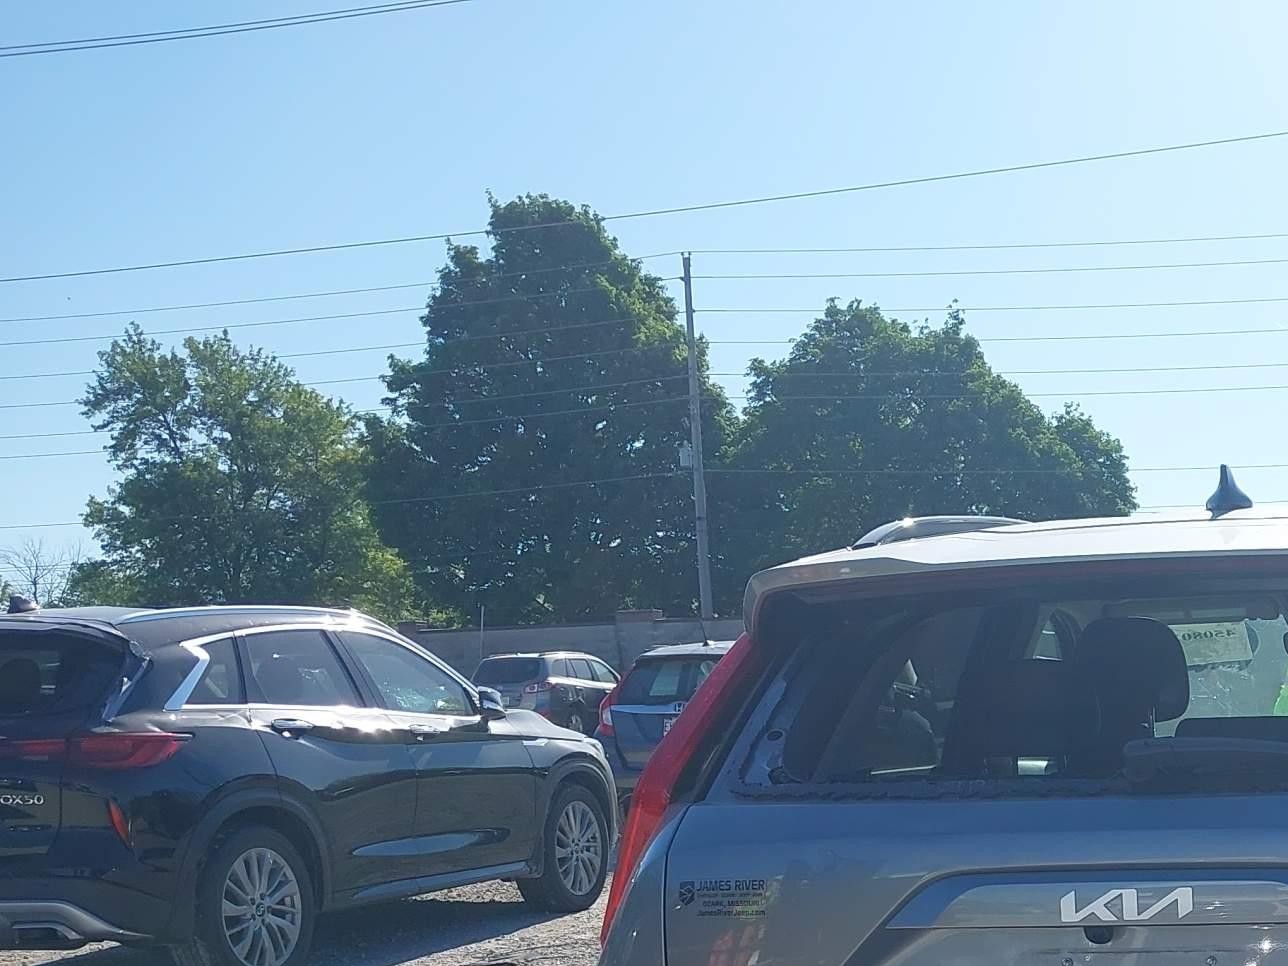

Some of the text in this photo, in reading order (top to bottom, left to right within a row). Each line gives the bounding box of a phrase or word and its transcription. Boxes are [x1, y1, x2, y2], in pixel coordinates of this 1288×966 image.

[696, 879, 765, 891] JAMES RIVER
[1060, 886, 1193, 923] KIA
